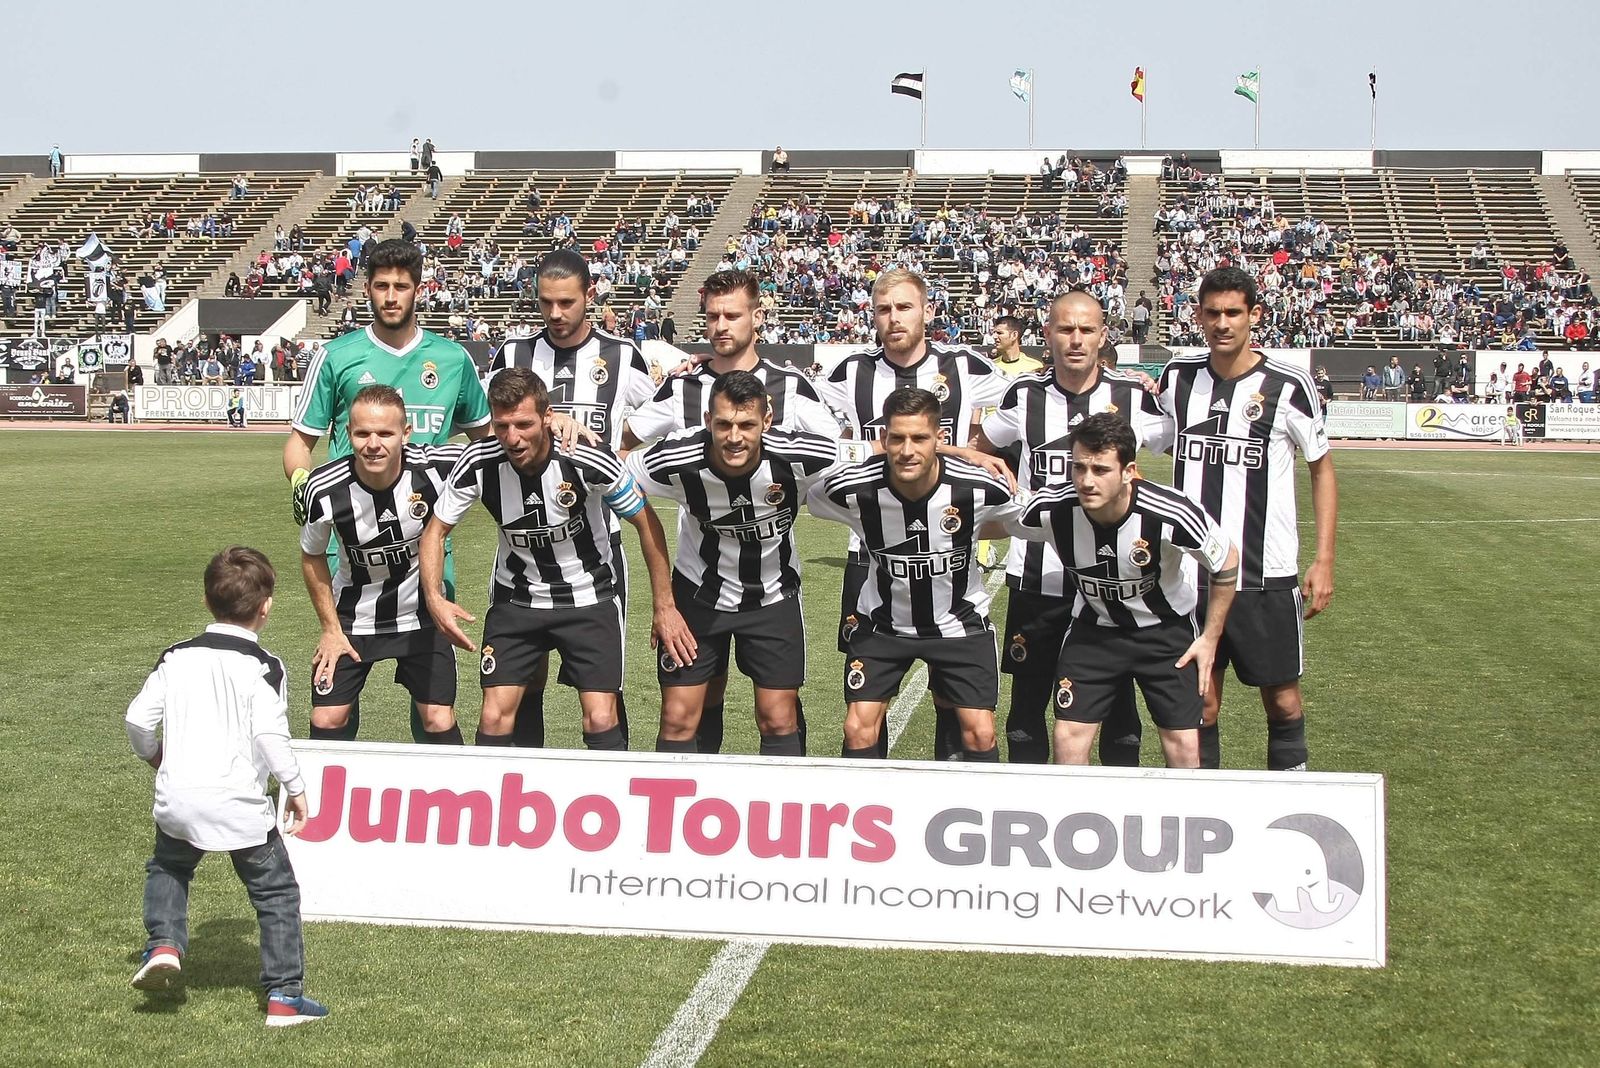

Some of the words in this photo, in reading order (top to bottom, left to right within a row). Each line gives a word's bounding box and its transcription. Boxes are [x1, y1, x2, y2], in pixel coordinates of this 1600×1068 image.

[141, 387, 283, 411] PRODNT
[1549, 404, 1564, 413] San
[1567, 404, 1595, 416] Roque
[145, 410, 175, 418] FRENTE
[178, 410, 188, 418] AL
[1178, 436, 1263, 469] LOTUS
[294, 765, 621, 852] Jumbo
[629, 778, 897, 863] Tours
[924, 807, 1235, 874] GROUP
[569, 867, 828, 905] International
[843, 878, 1040, 919] Incoming
[1055, 886, 1233, 920] Network
